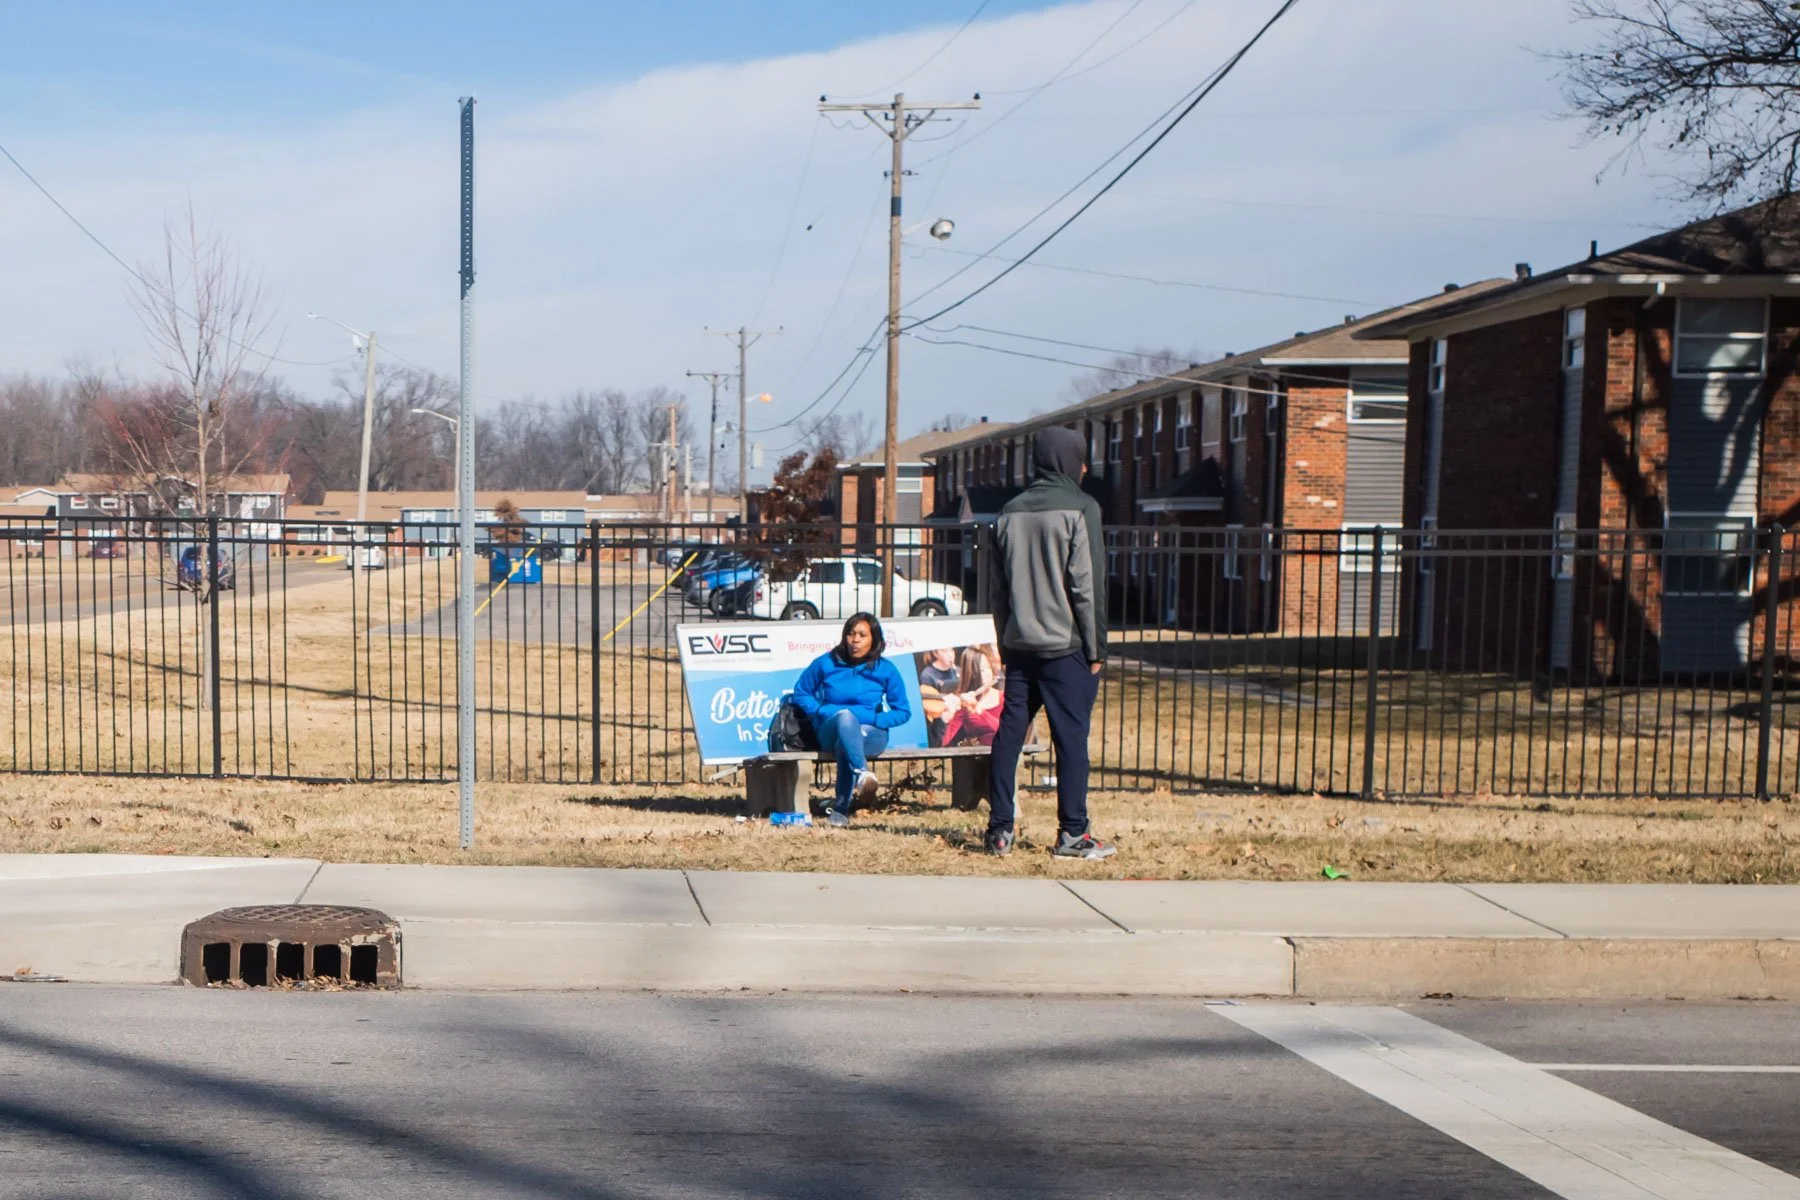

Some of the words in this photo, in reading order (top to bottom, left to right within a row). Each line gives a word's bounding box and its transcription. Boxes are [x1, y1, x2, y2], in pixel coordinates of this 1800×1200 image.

[688, 633, 771, 655] EVSC
[787, 640, 832, 653] Bringing
[736, 724, 752, 742] In
